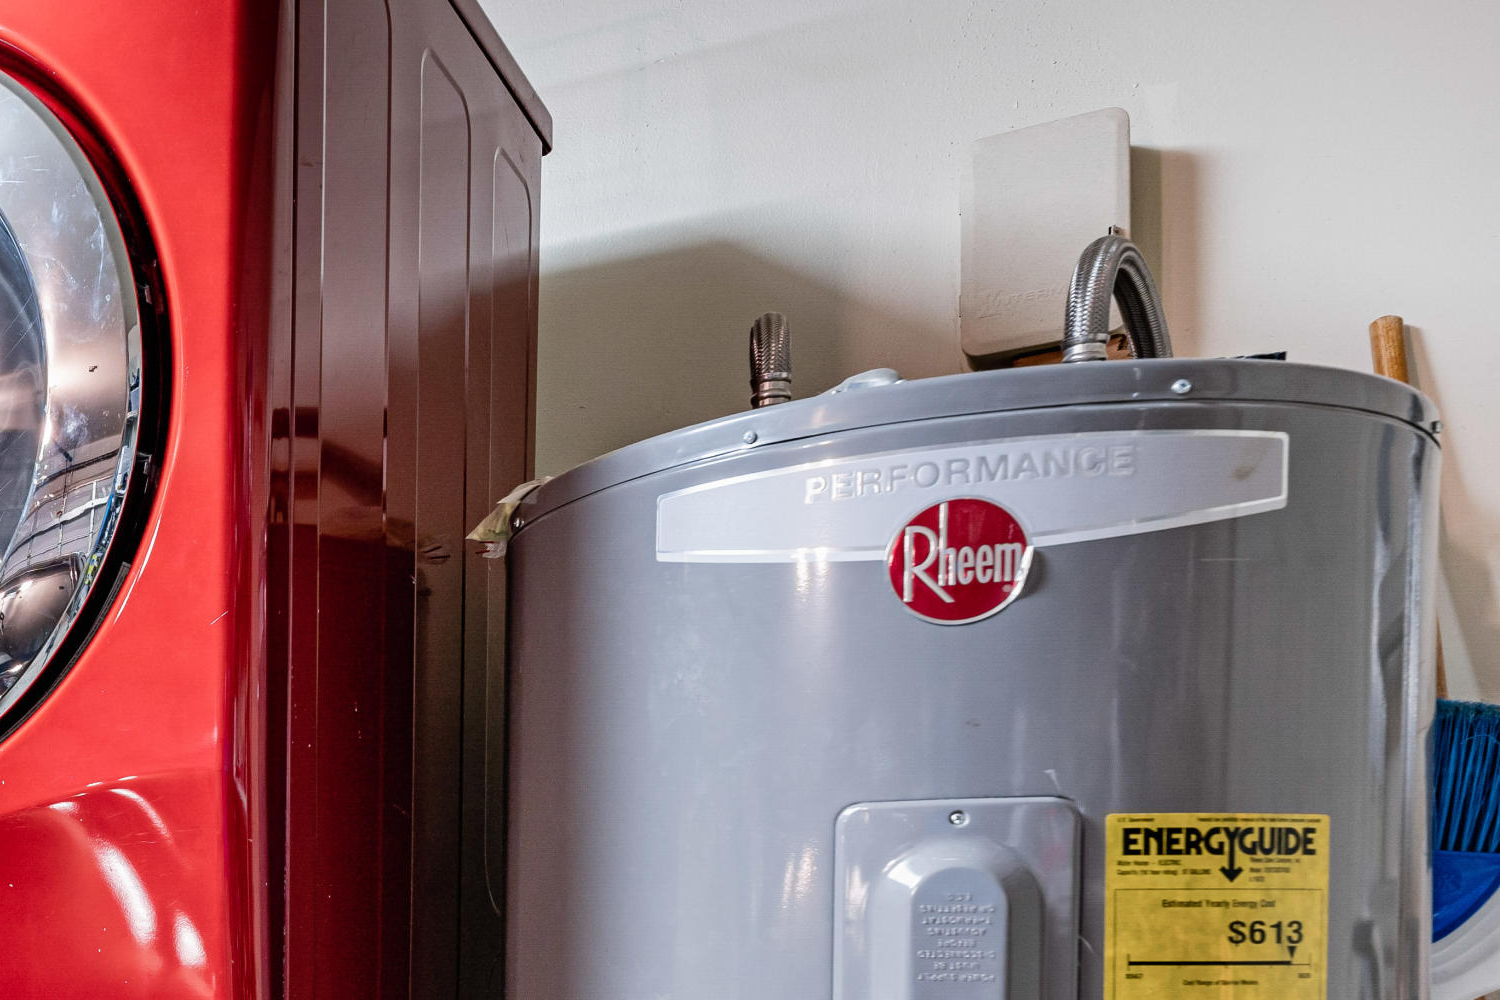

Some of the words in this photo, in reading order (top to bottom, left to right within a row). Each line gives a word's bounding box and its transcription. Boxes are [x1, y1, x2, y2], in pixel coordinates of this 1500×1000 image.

[804, 444, 1137, 504] PERFORMANCE
[903, 502, 1026, 603] Rheem
[1122, 827, 1317, 857] ENERGYGUIDE
[1161, 898, 1203, 908] Estimated
[1205, 898, 1231, 909] Yearly
[1232, 898, 1258, 910] Energy
[1260, 898, 1277, 908] Cost
[1228, 920, 1304, 946] $613
